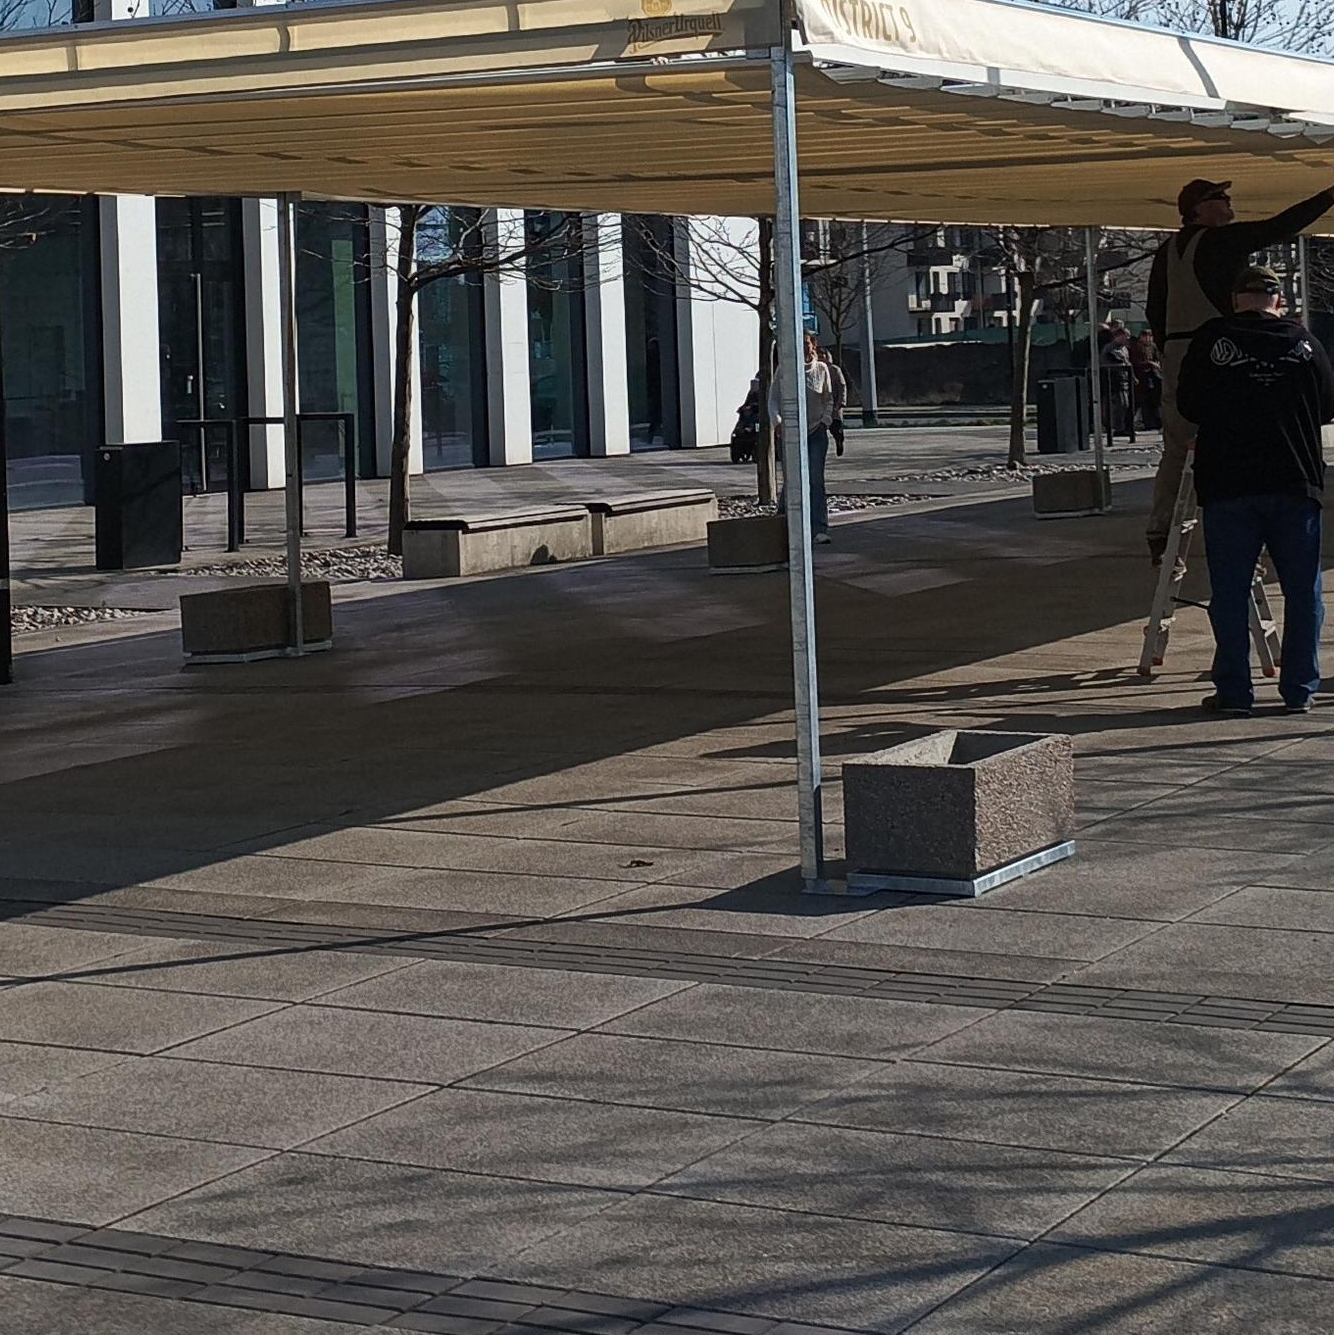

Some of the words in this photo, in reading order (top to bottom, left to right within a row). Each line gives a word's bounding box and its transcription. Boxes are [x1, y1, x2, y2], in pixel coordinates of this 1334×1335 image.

[627, 15, 676, 54] Pilsner
[673, 11, 722, 39] Urquell
[899, 6, 916, 42] 9
